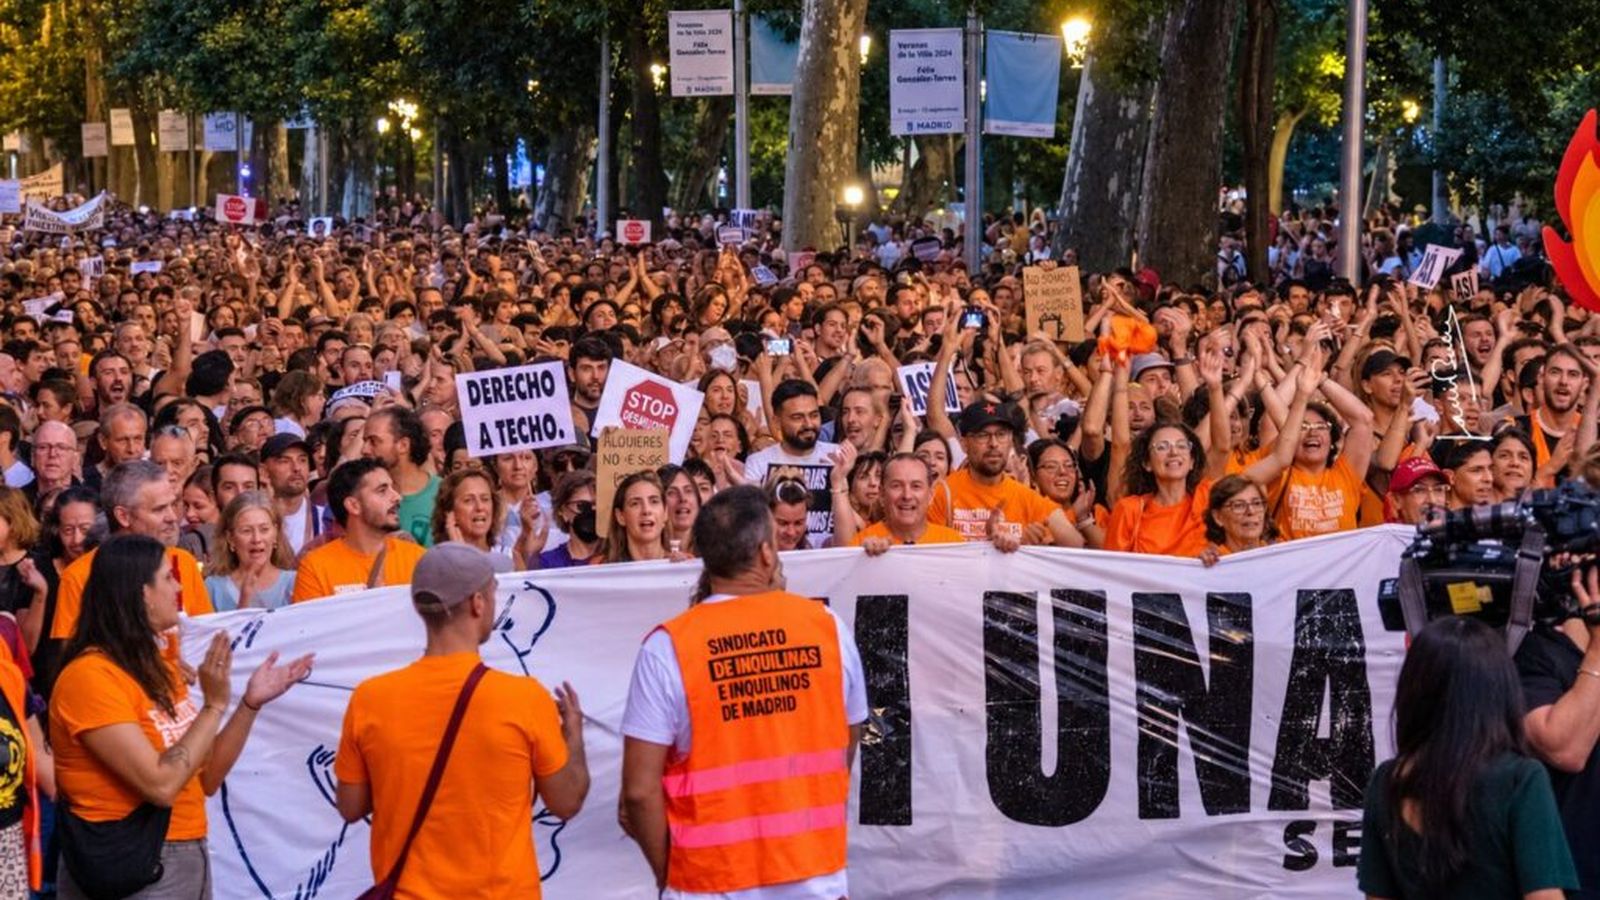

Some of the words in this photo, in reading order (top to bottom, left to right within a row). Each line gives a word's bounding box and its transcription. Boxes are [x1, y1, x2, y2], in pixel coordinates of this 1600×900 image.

[917, 50, 933, 58] Villa
[934, 49, 952, 57] 2024
[917, 121, 952, 129] MADRID
[466, 369, 555, 407] DERECHO
[628, 391, 675, 420] STOP
[480, 422, 494, 450] A
[495, 413, 565, 447] TECHO.
[707, 628, 787, 655] SINDICATO
[712, 659, 735, 679] DE
[734, 648, 819, 676] INQUILINAS
[717, 684, 728, 701] E
[729, 672, 811, 700] INQUILINOS
[721, 703, 740, 722] DE
[742, 695, 797, 718] MADRID
[982, 587, 1376, 828] UNA
